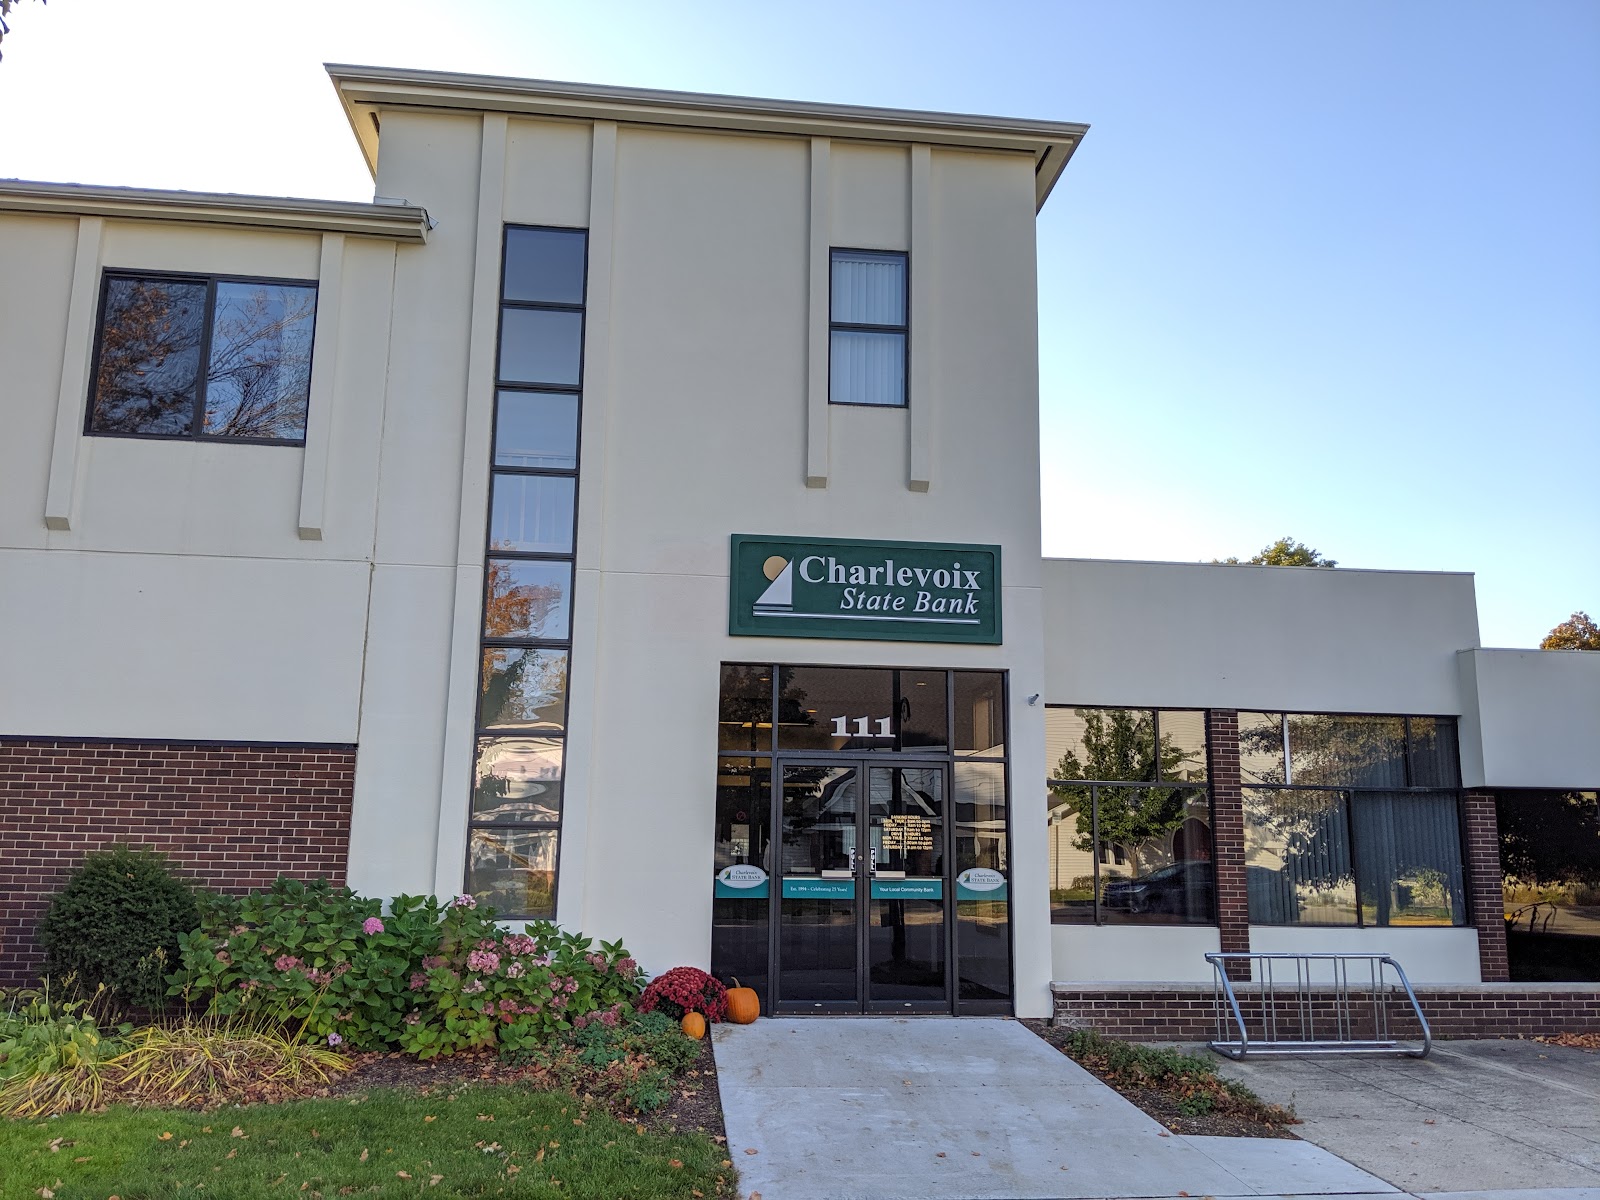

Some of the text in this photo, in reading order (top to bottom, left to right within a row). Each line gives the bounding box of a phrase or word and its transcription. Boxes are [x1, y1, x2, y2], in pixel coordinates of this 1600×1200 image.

[799, 555, 982, 590] Charlevoix
[840, 587, 980, 615] State Bank
[830, 715, 896, 738] 111
